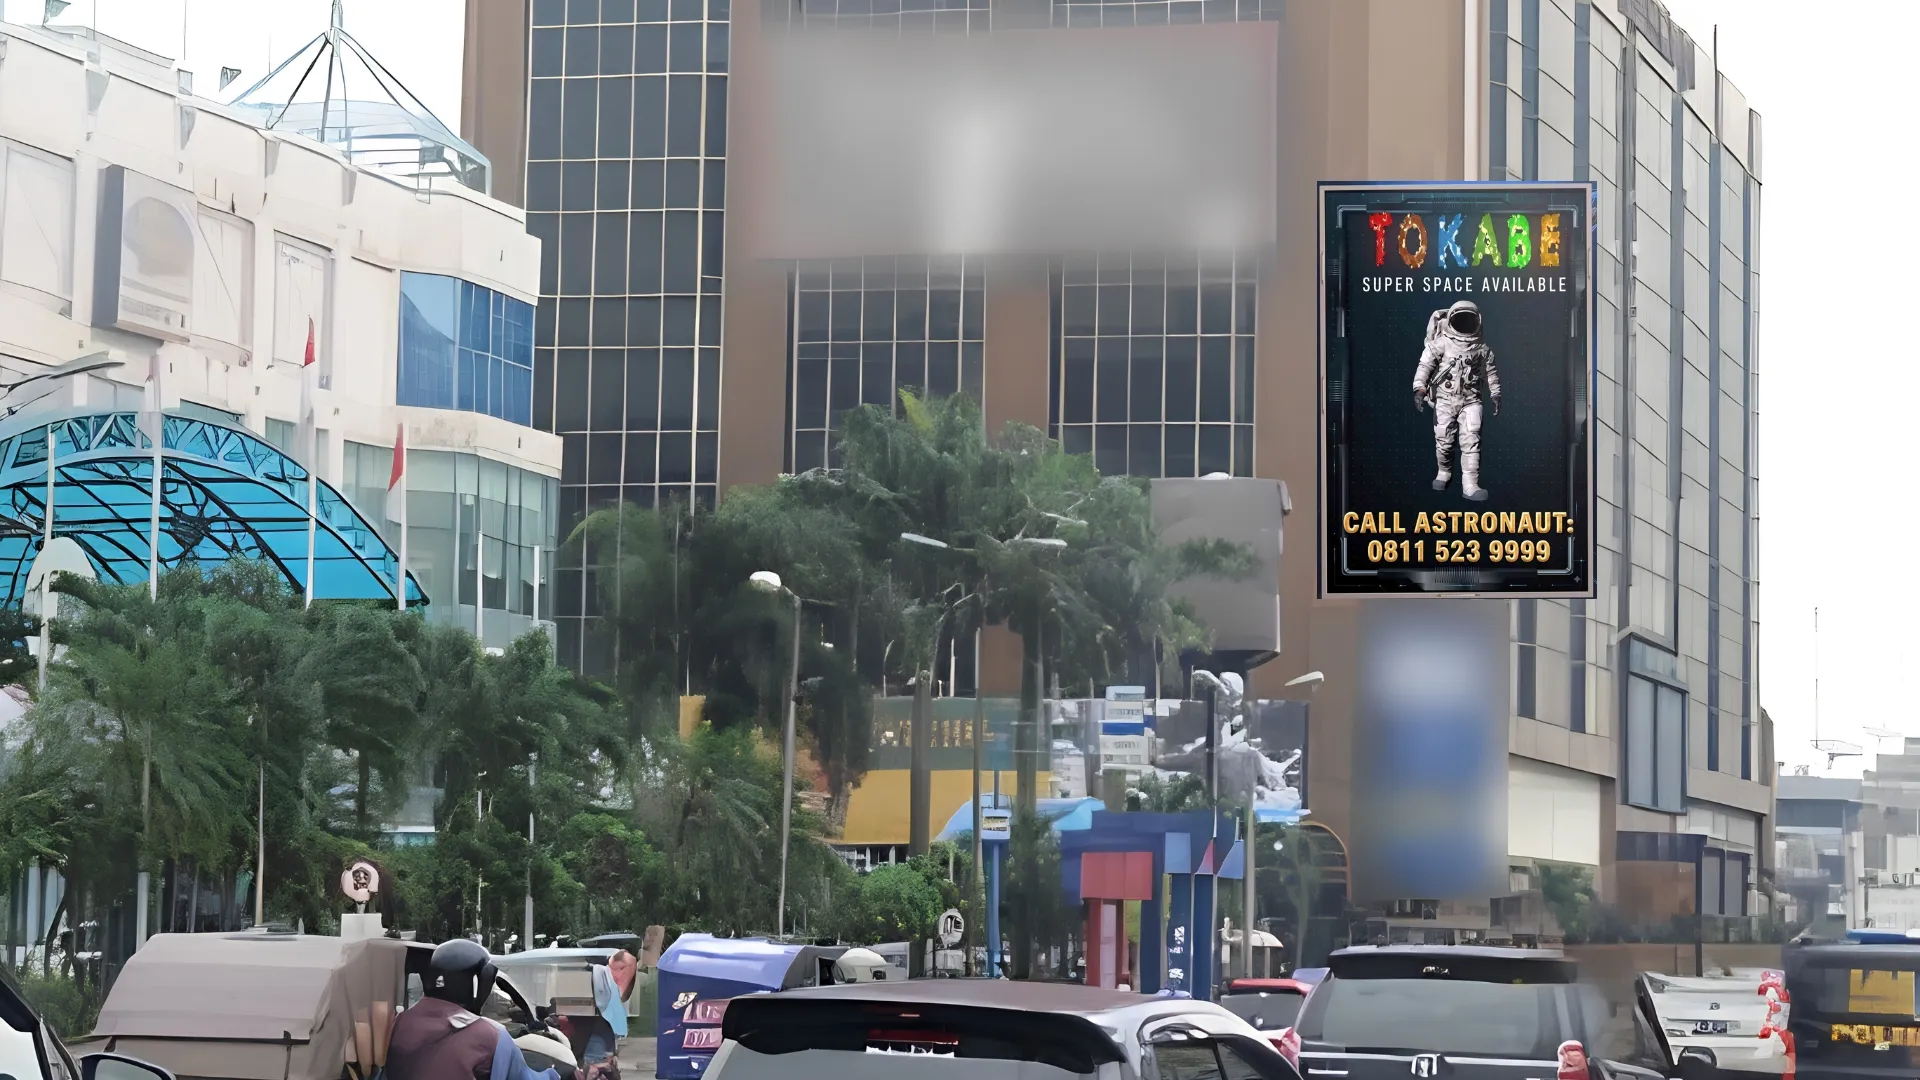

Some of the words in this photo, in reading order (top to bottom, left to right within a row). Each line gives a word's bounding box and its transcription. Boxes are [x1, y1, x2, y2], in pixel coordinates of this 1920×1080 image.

[1369, 212, 1561, 269] TOKABE
[1362, 277, 1414, 292] SUPER
[1423, 277, 1473, 292] SPACE
[1481, 277, 1567, 292] AVAILABLE
[1343, 511, 1406, 534] CALL
[1414, 512, 1574, 534] ASTRONAUT:
[1367, 540, 1424, 563] 0811
[1435, 540, 1481, 563] 523
[1489, 540, 1551, 563] 9999
